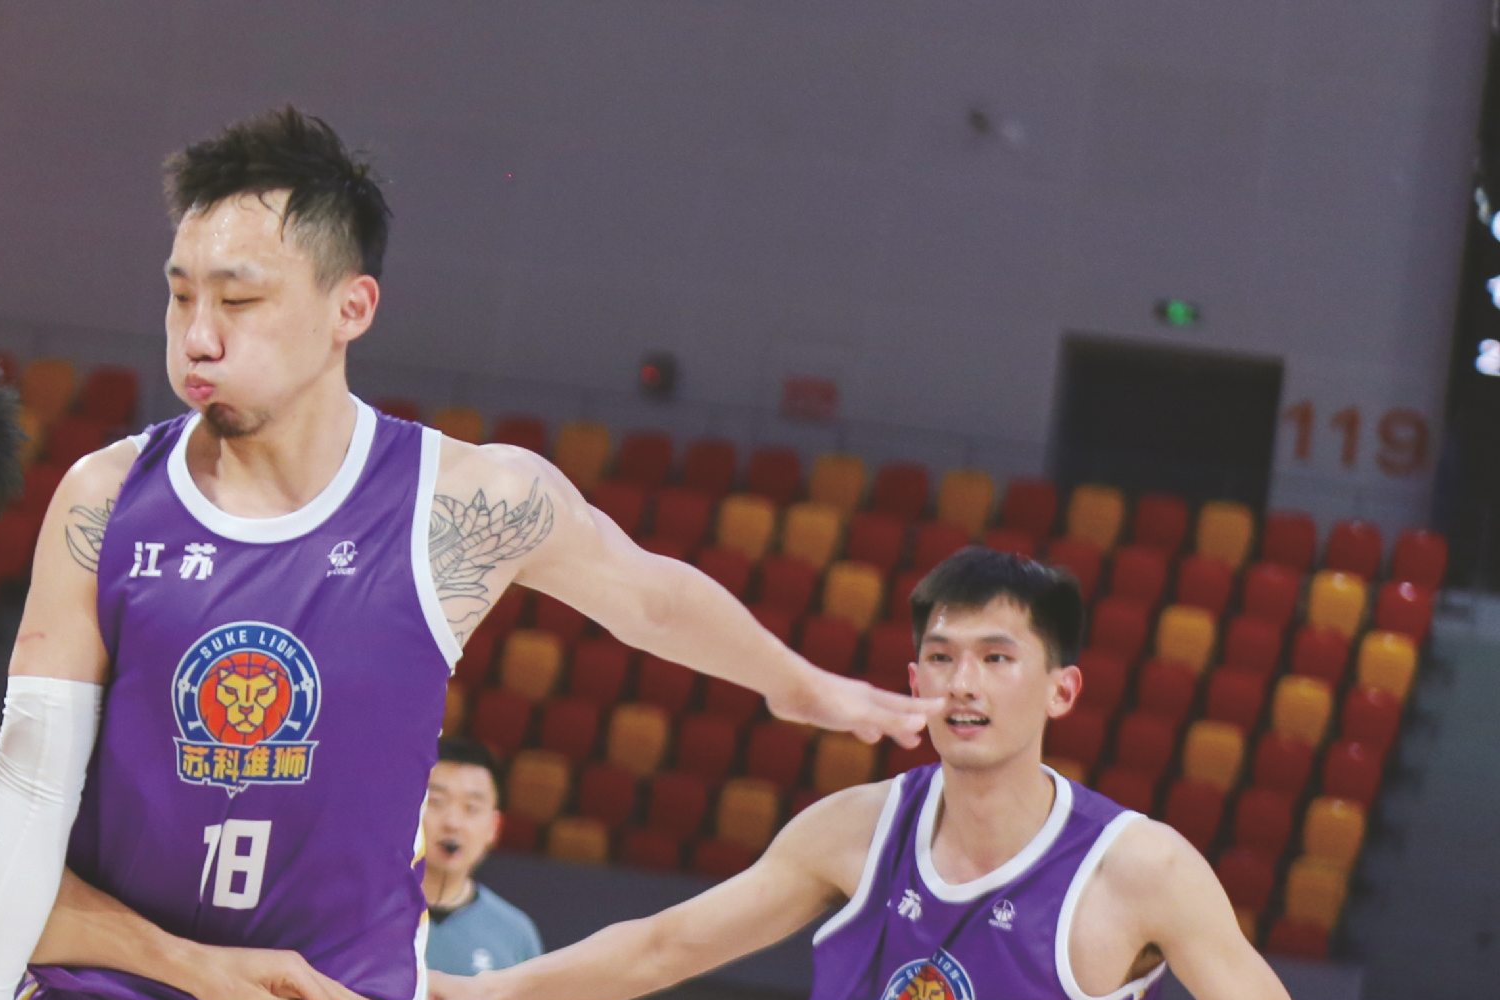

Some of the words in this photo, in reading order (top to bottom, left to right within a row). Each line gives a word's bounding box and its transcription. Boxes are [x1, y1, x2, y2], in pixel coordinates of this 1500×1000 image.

[1283, 400, 1430, 478] 119
[129, 541, 217, 580] 江苏
[200, 629, 247, 659] SUKE
[259, 631, 296, 659] LION
[182, 744, 308, 783] 苏科雄狮
[199, 818, 272, 910] 18
